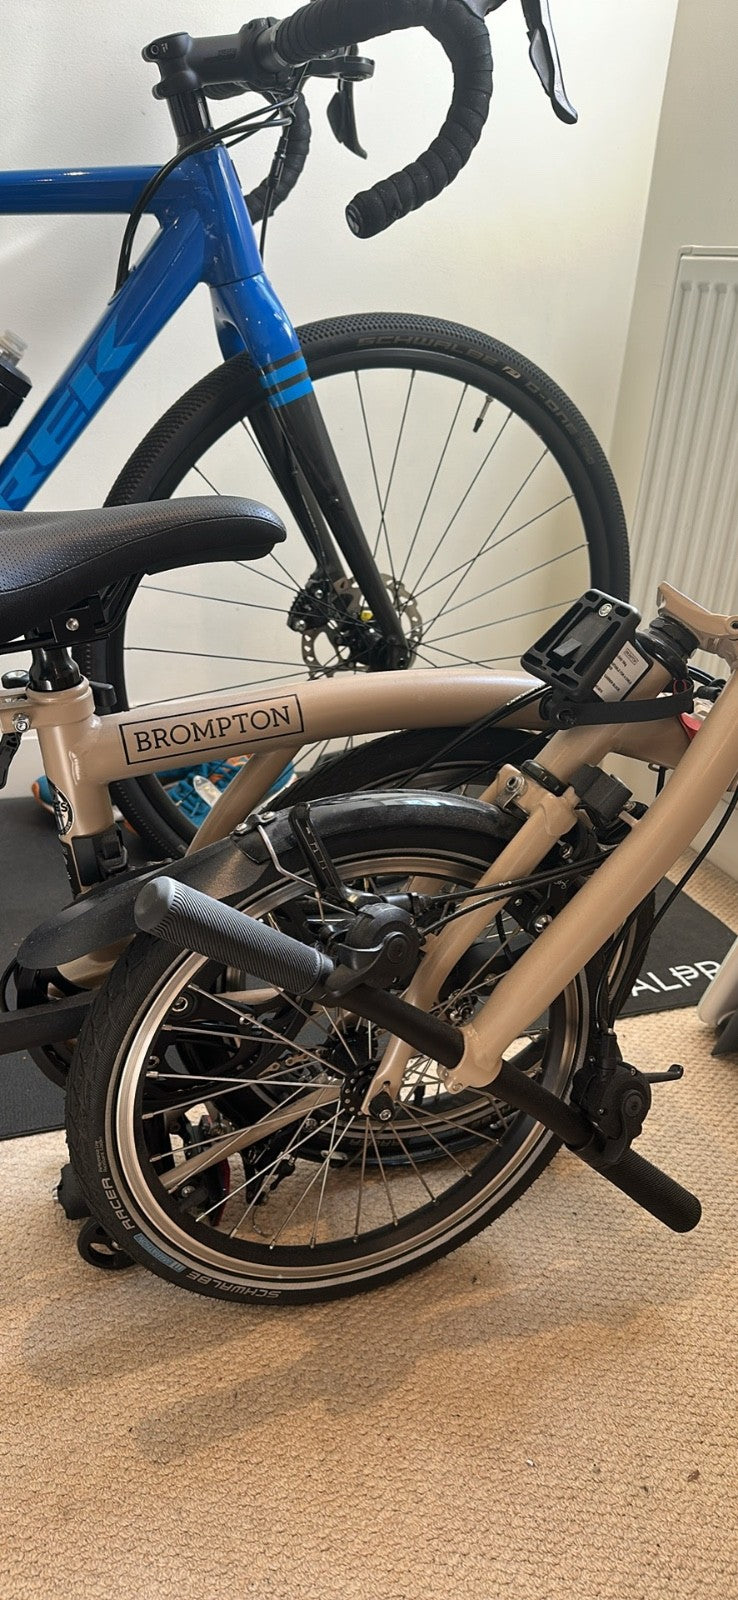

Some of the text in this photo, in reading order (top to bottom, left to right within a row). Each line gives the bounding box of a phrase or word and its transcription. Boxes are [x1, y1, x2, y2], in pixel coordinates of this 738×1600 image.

[357, 335, 498, 367] SCHWALBE
[134, 705, 291, 752] BROMPTON
[101, 1177, 135, 1230] RACER
[186, 1271, 282, 1299] SCHWALBE
